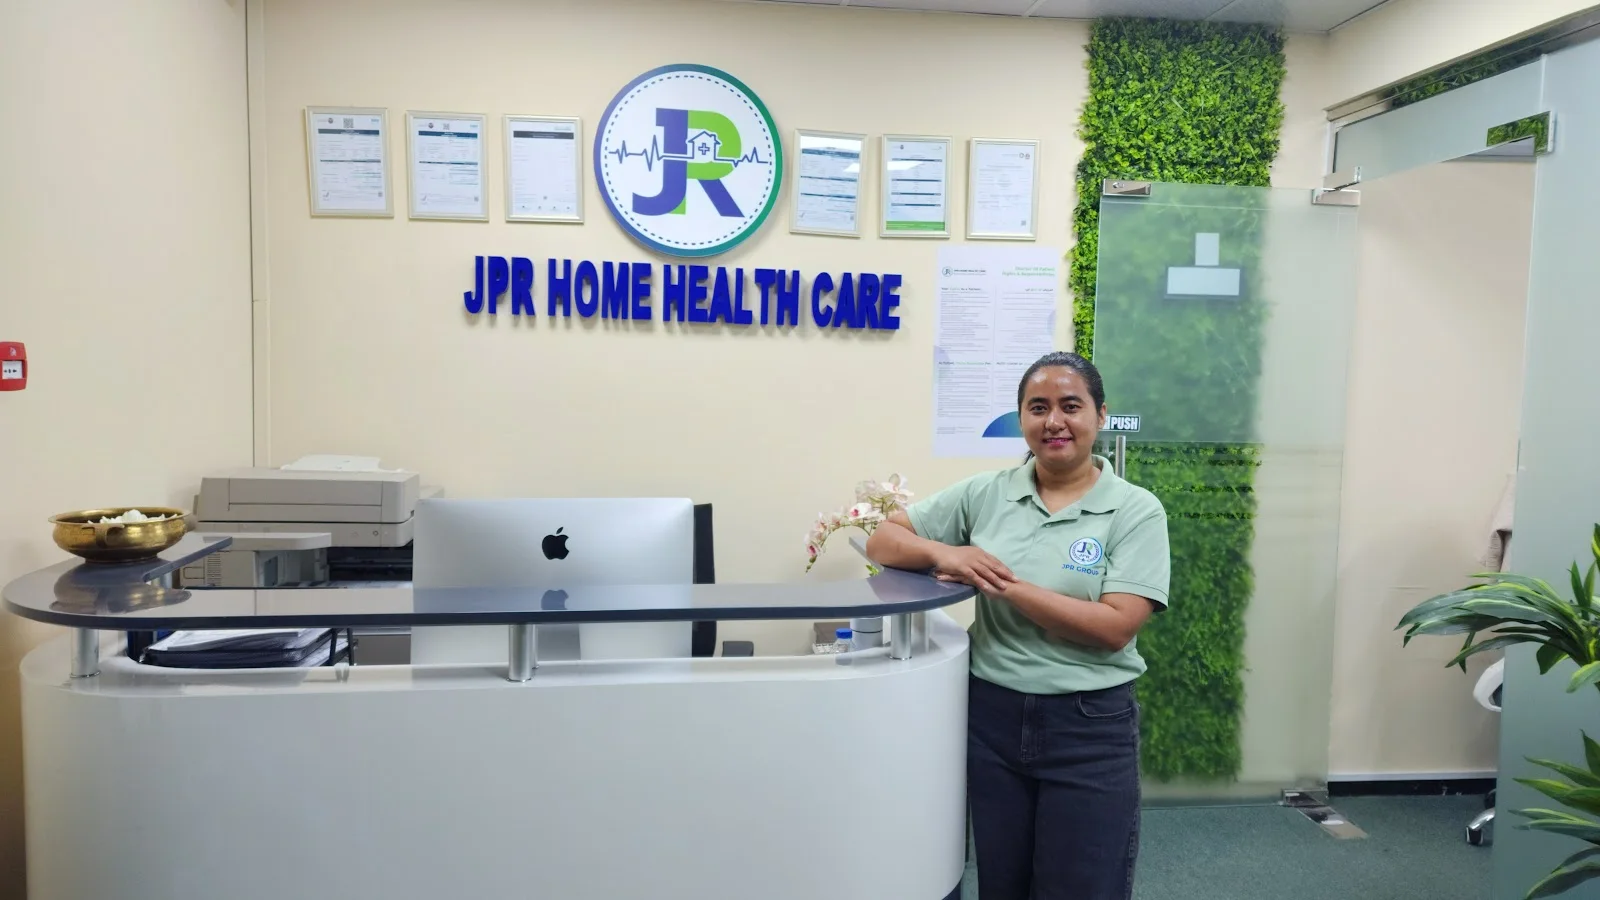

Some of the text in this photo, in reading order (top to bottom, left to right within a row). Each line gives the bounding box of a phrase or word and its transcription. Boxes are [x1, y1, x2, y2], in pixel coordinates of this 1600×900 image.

[464, 256, 536, 316] JPR
[548, 259, 653, 321] HOME
[663, 264, 801, 328] HEALTH
[812, 272, 903, 331] CARE
[1110, 416, 1139, 430] PUSH
[1061, 563, 1099, 577] JPR GROUP
